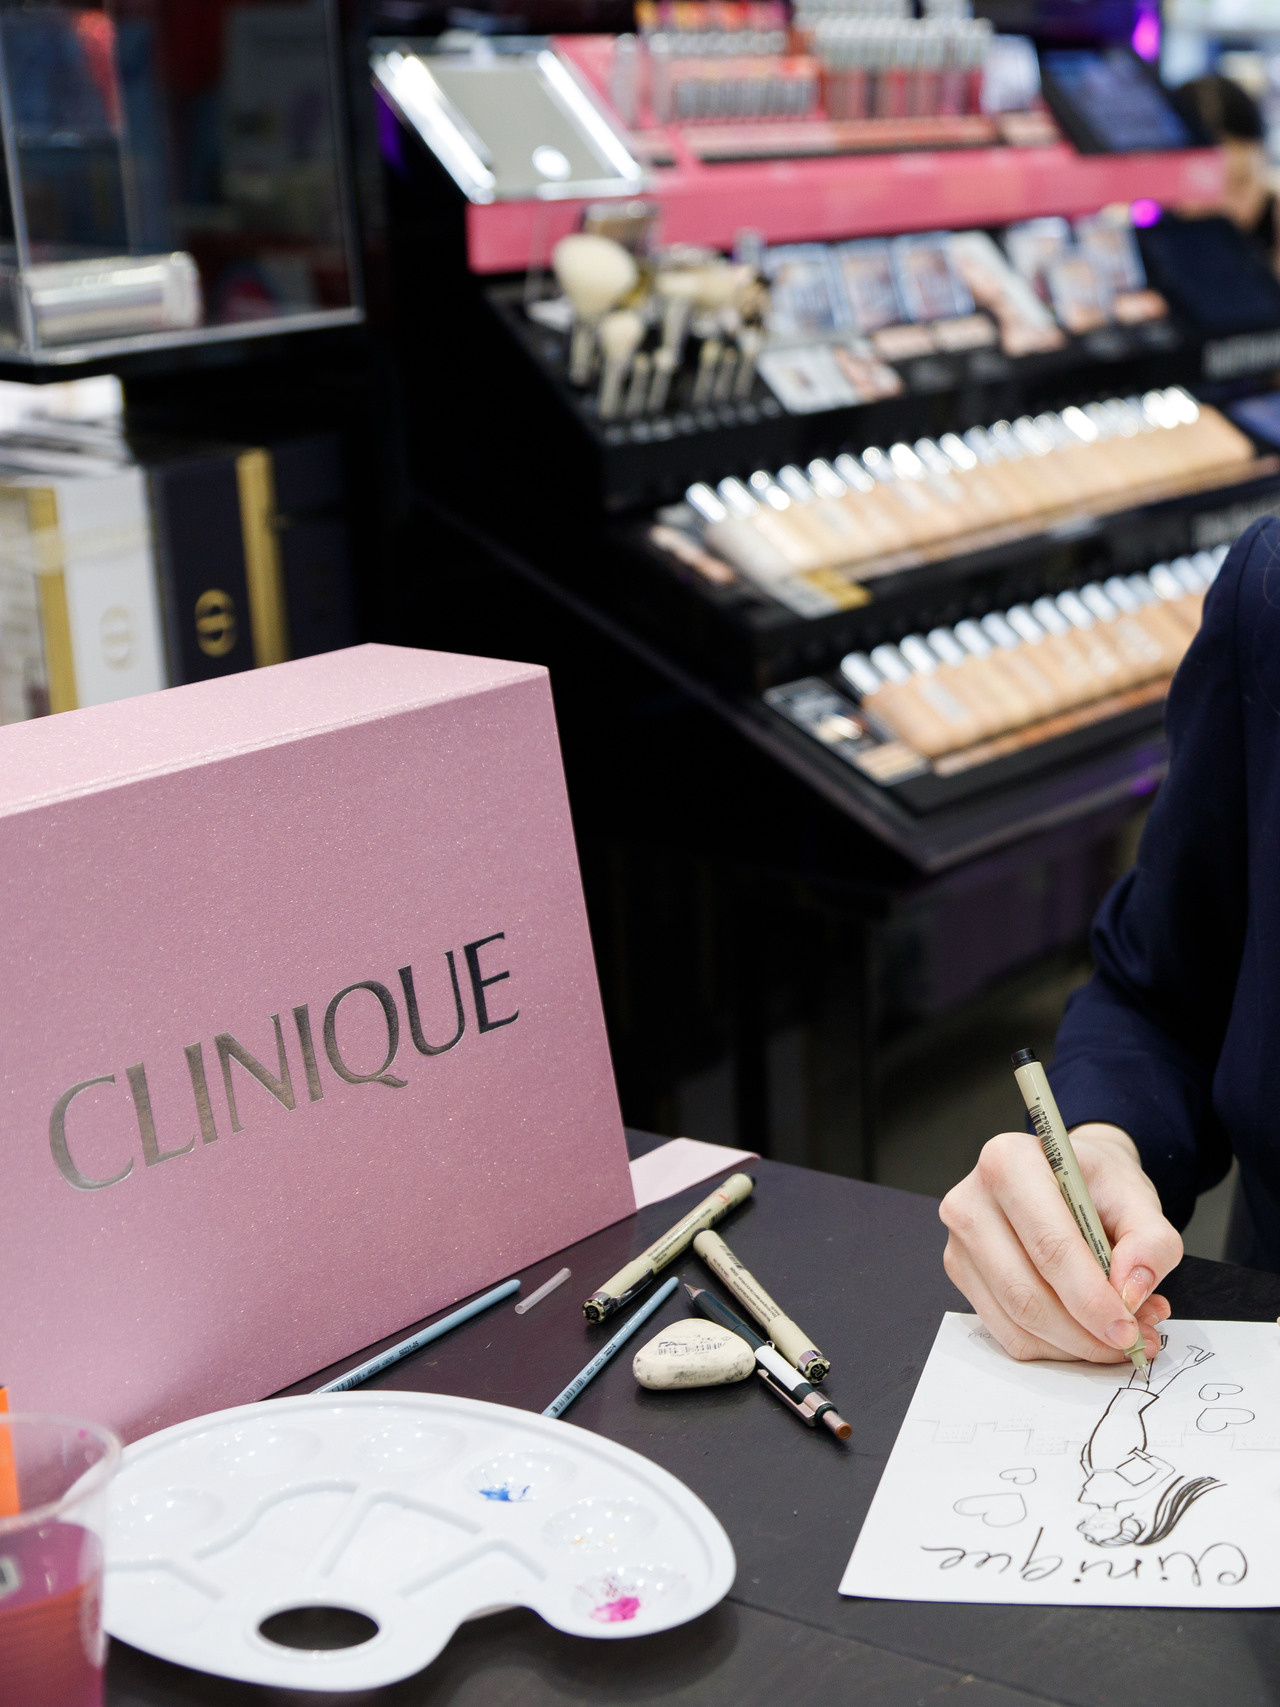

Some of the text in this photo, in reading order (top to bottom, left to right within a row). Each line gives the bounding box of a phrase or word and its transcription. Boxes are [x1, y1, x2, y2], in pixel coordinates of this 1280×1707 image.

[48, 931, 520, 1192] CLINIQUE
[1040, 1110, 1053, 1136] 30644
[1049, 1137, 1064, 1162] 84511
[1079, 1204, 1093, 1233] CORPORATION
[1089, 1233, 1100, 1255] PRODUCTS
[1098, 1254, 1108, 1270] COLOR
[811, 1364, 824, 1377] 02
